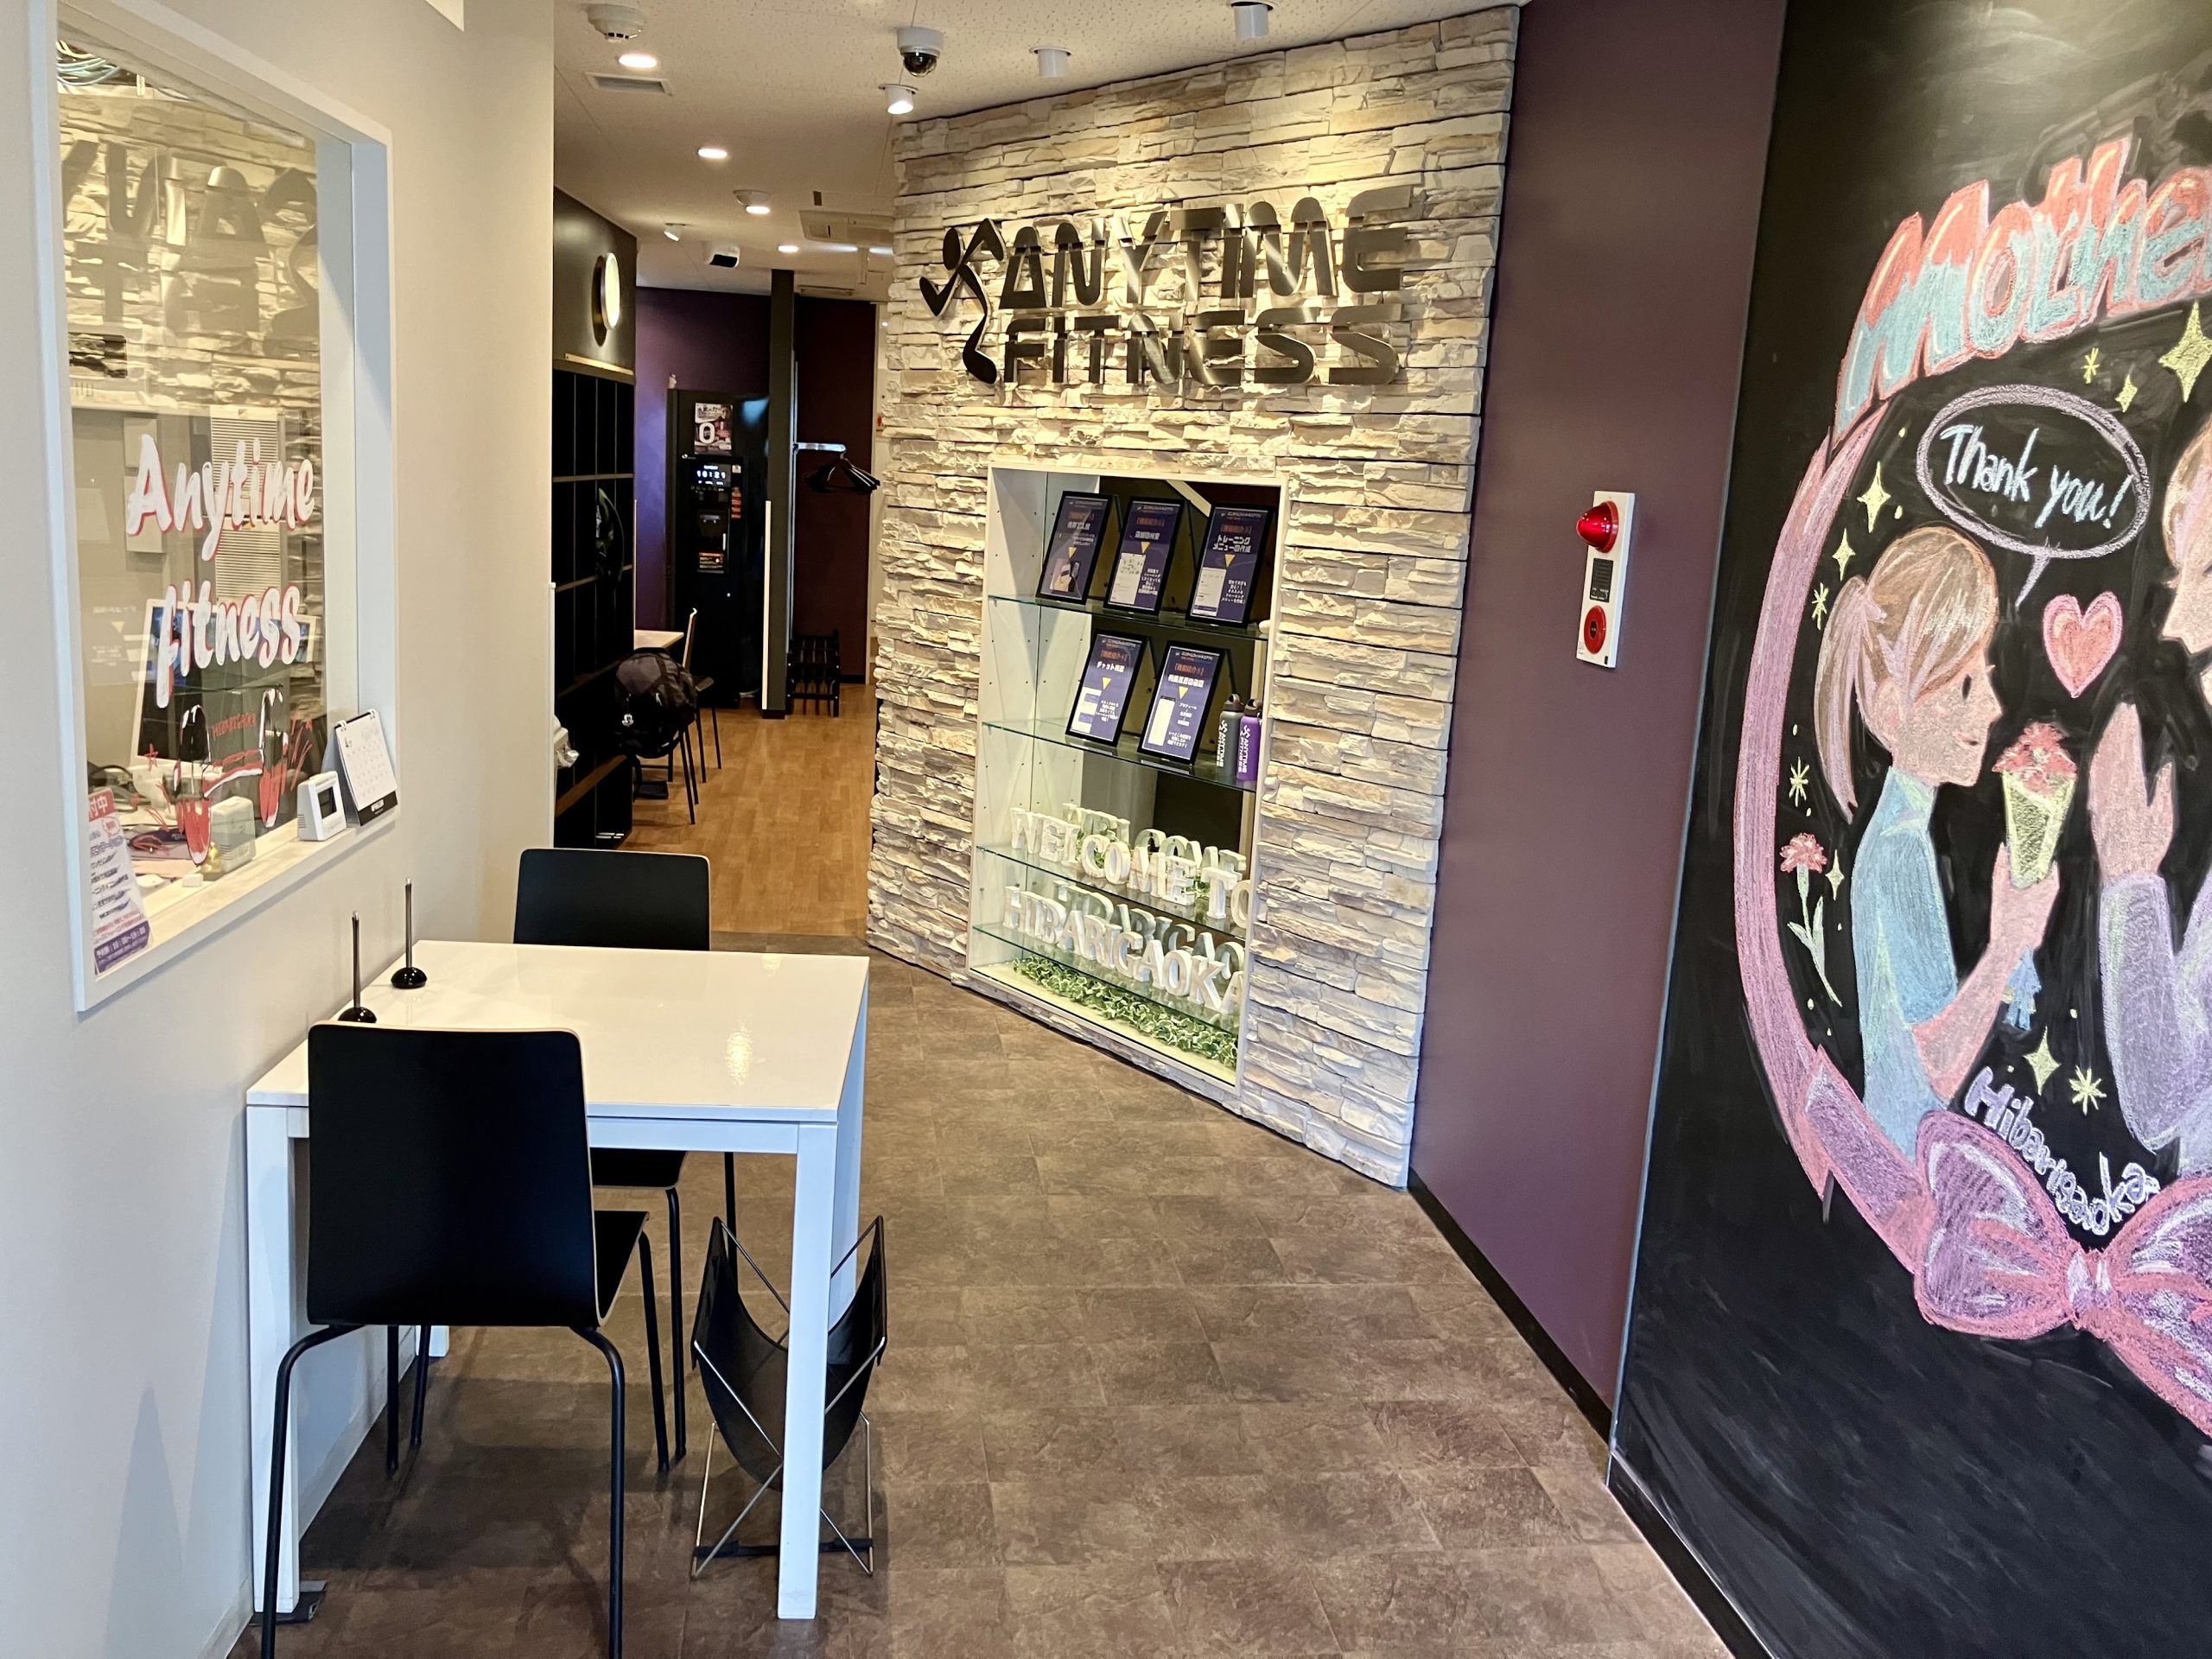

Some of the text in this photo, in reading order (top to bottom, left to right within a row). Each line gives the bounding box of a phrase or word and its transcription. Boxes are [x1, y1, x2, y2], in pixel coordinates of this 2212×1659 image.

[998, 185, 1412, 309] ANYTIME
[1833, 135, 2212, 449] Mothe
[1003, 304, 1403, 385] FITNESS
[126, 433, 315, 562] Anytime
[1939, 423, 2134, 530] Thank you!
[1010, 807, 1198, 906] WELCOME
